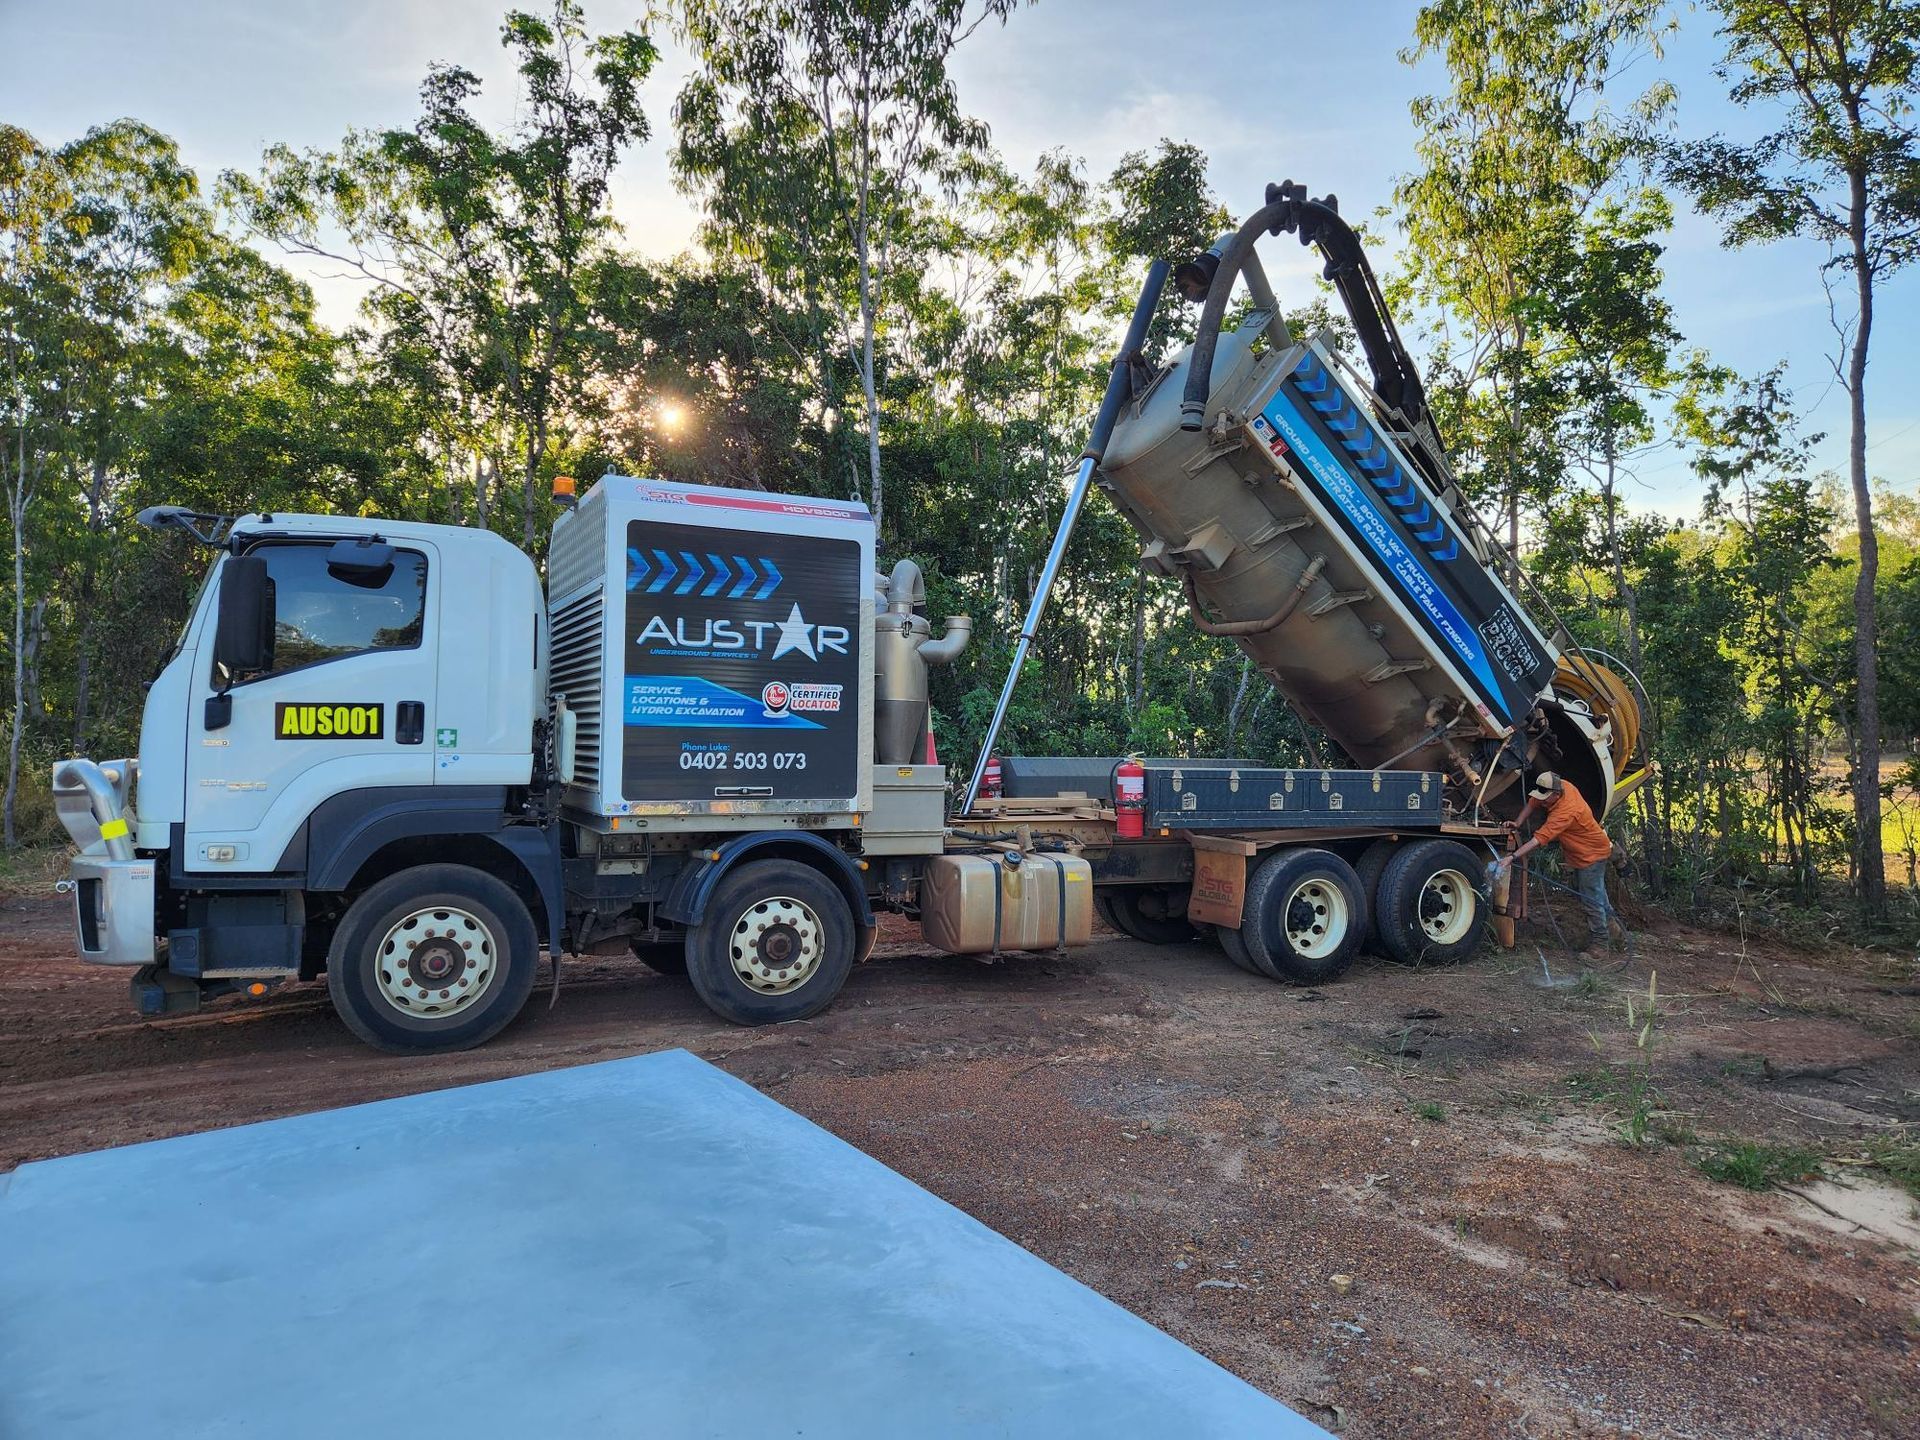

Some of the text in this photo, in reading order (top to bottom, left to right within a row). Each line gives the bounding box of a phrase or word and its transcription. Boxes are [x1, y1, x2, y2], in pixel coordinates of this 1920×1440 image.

[1275, 414, 1475, 661] GROUND PENETRATING RADAR CABLE FAULT FINDING
[1388, 538, 1405, 557] VAC
[1403, 557, 1434, 595] TRUCKS
[1497, 611, 1536, 671] TERRITORY
[650, 648, 711, 658] UNDERGROUND
[711, 651, 749, 659] SERVICES
[632, 685, 683, 695] SERVICE
[792, 690, 839, 699] CERTIFIED
[632, 696, 709, 706] LOCATIONS &
[793, 700, 838, 709] LOCATOR
[631, 706, 745, 716] HYDRO EXCAVATION
[282, 706, 378, 735] AUS001
[682, 742, 731, 751] Phone Luke:
[679, 752, 807, 770] 0402 503 073
